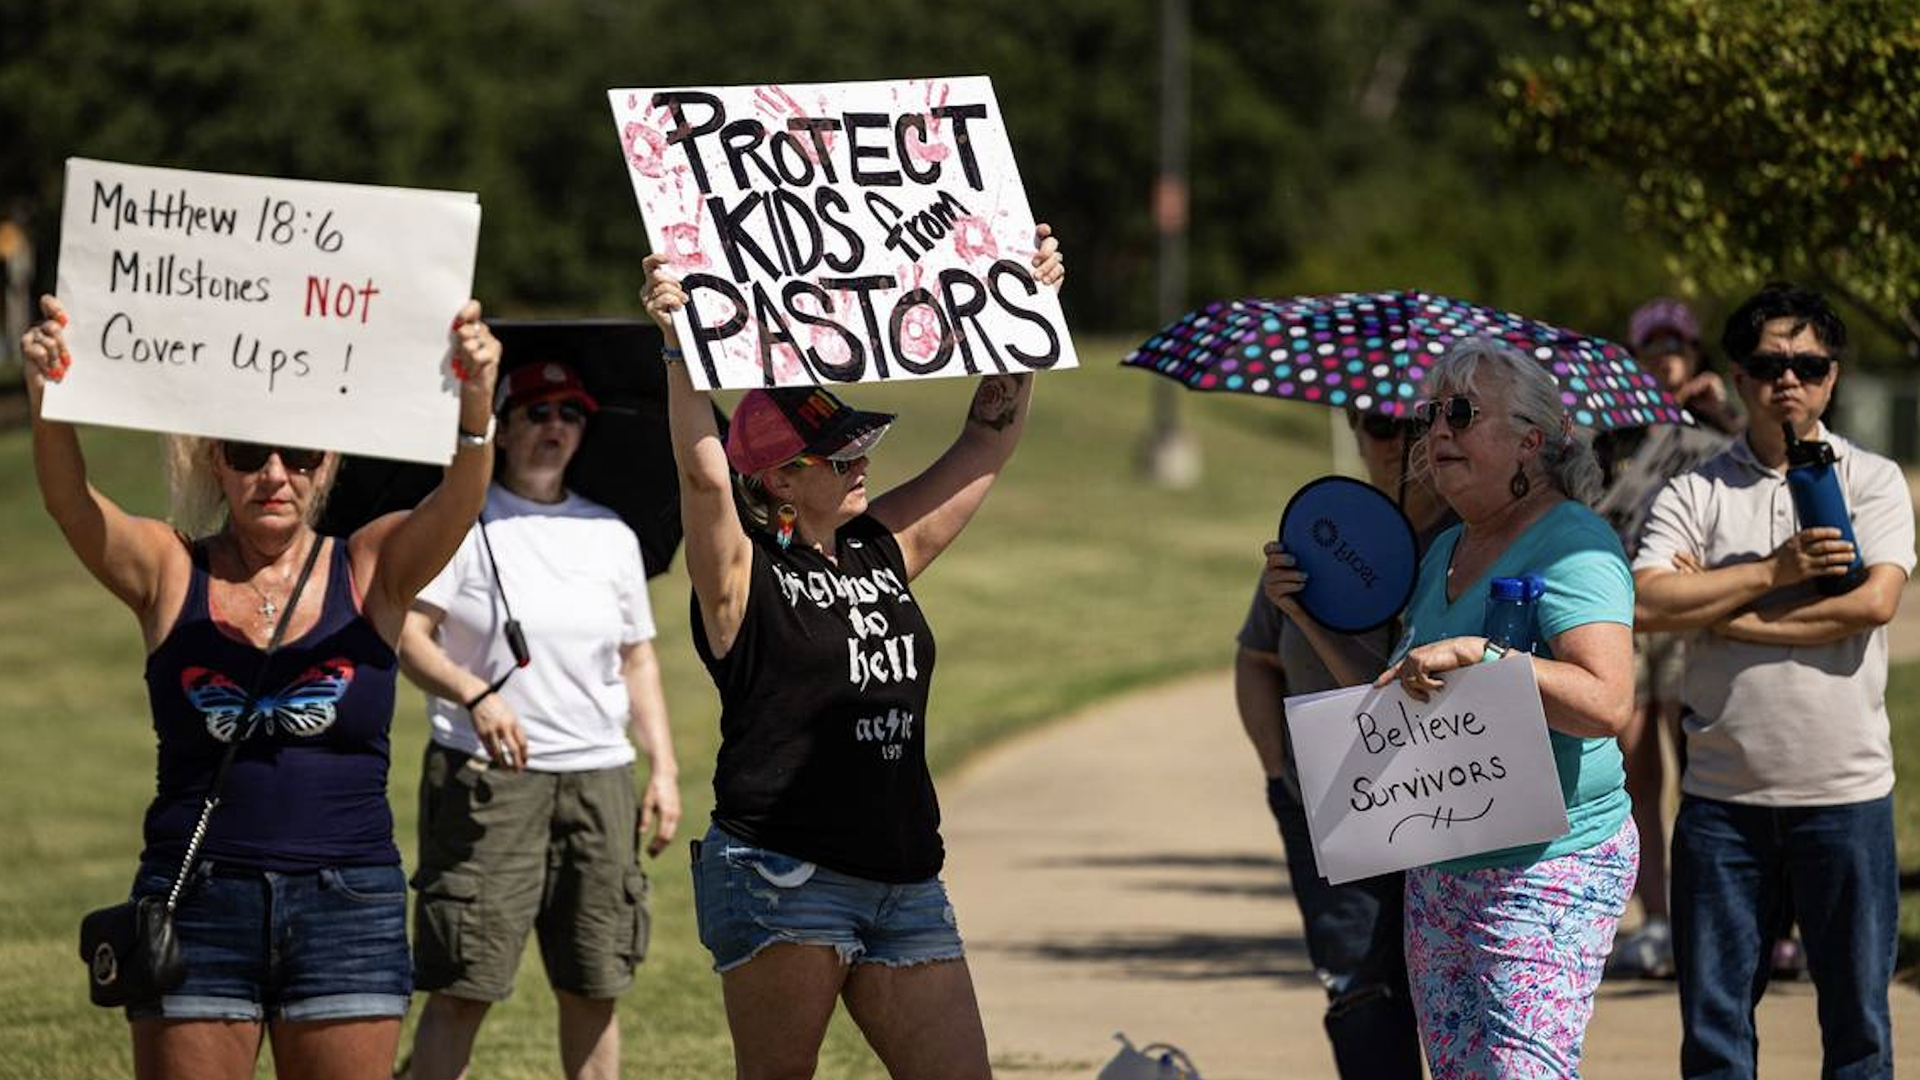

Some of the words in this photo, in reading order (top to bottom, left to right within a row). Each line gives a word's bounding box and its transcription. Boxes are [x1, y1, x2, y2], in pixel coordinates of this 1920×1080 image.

[652, 91, 989, 194] PROTECT
[91, 180, 237, 236] Matthew
[256, 197, 343, 253] 18:6
[706, 186, 866, 283] KIDS
[864, 189, 972, 262] from
[109, 250, 270, 302] Millstones
[100, 313, 206, 364] Cover
[681, 259, 1061, 389] PASTORS
[848, 605, 889, 640] to
[847, 633, 918, 692] hell
[1356, 701, 1486, 755] Believe
